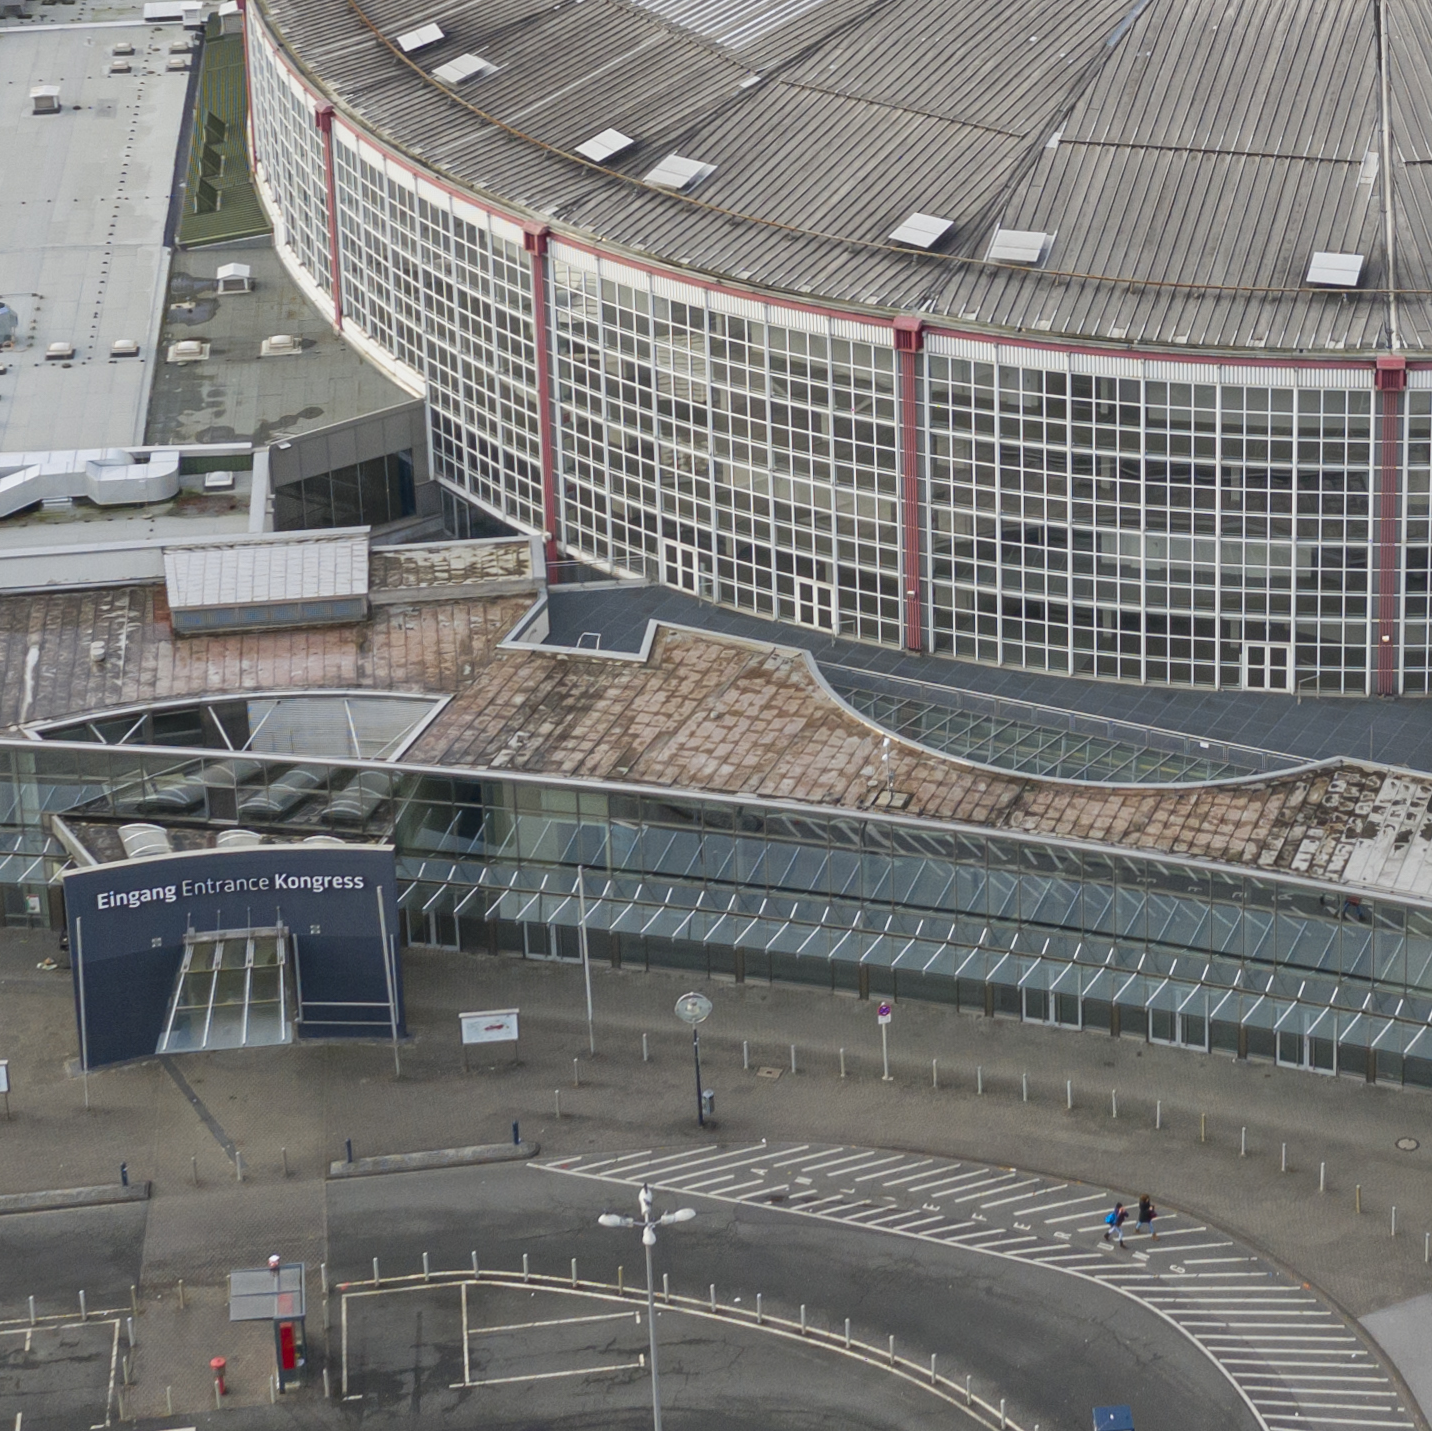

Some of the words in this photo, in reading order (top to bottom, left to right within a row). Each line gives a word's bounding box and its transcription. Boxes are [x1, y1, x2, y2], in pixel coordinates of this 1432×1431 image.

[97, 885, 176, 910] Eingang
[182, 875, 269, 897] Entrance
[274, 873, 365, 893] Kongress
